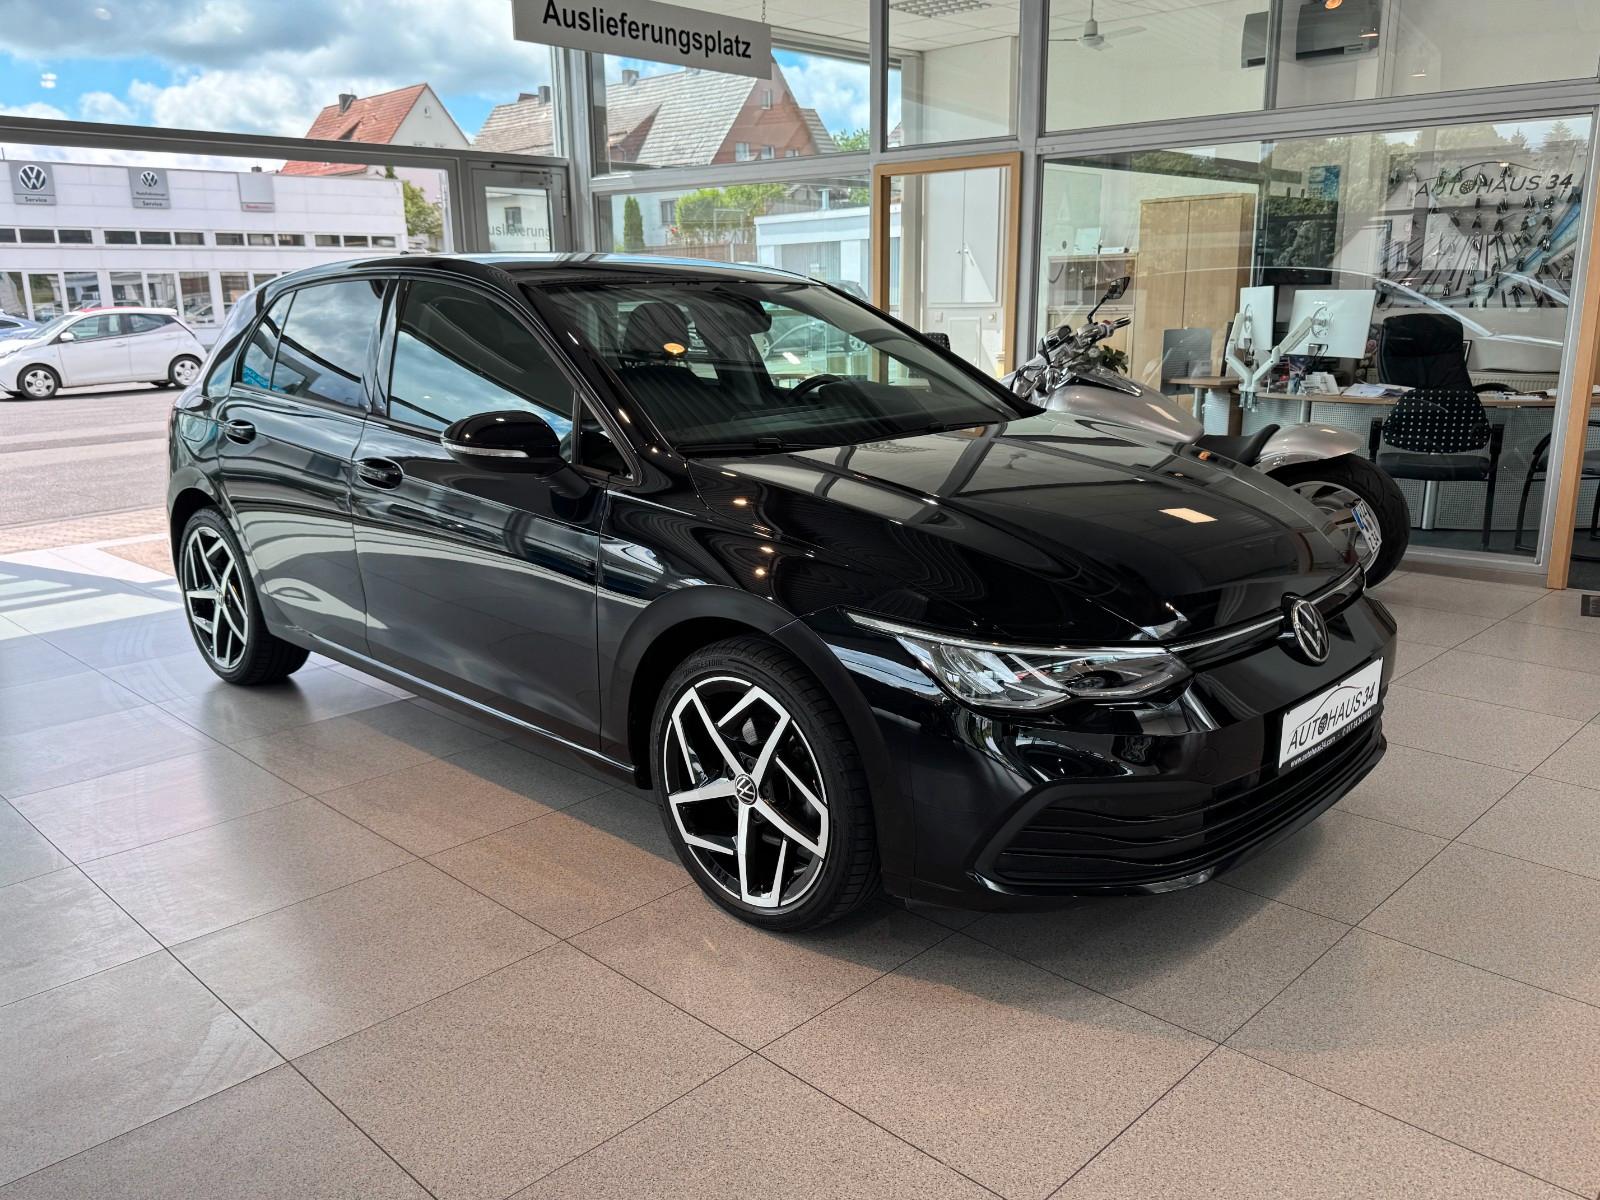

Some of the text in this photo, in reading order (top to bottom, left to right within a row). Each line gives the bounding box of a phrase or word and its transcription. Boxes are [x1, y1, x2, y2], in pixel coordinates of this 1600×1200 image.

[542, 0, 752, 59] Auslieferungsplatz
[1545, 173, 1574, 191] 34
[1286, 691, 1363, 756] AUTOHAUS
[1362, 681, 1376, 707] 34
